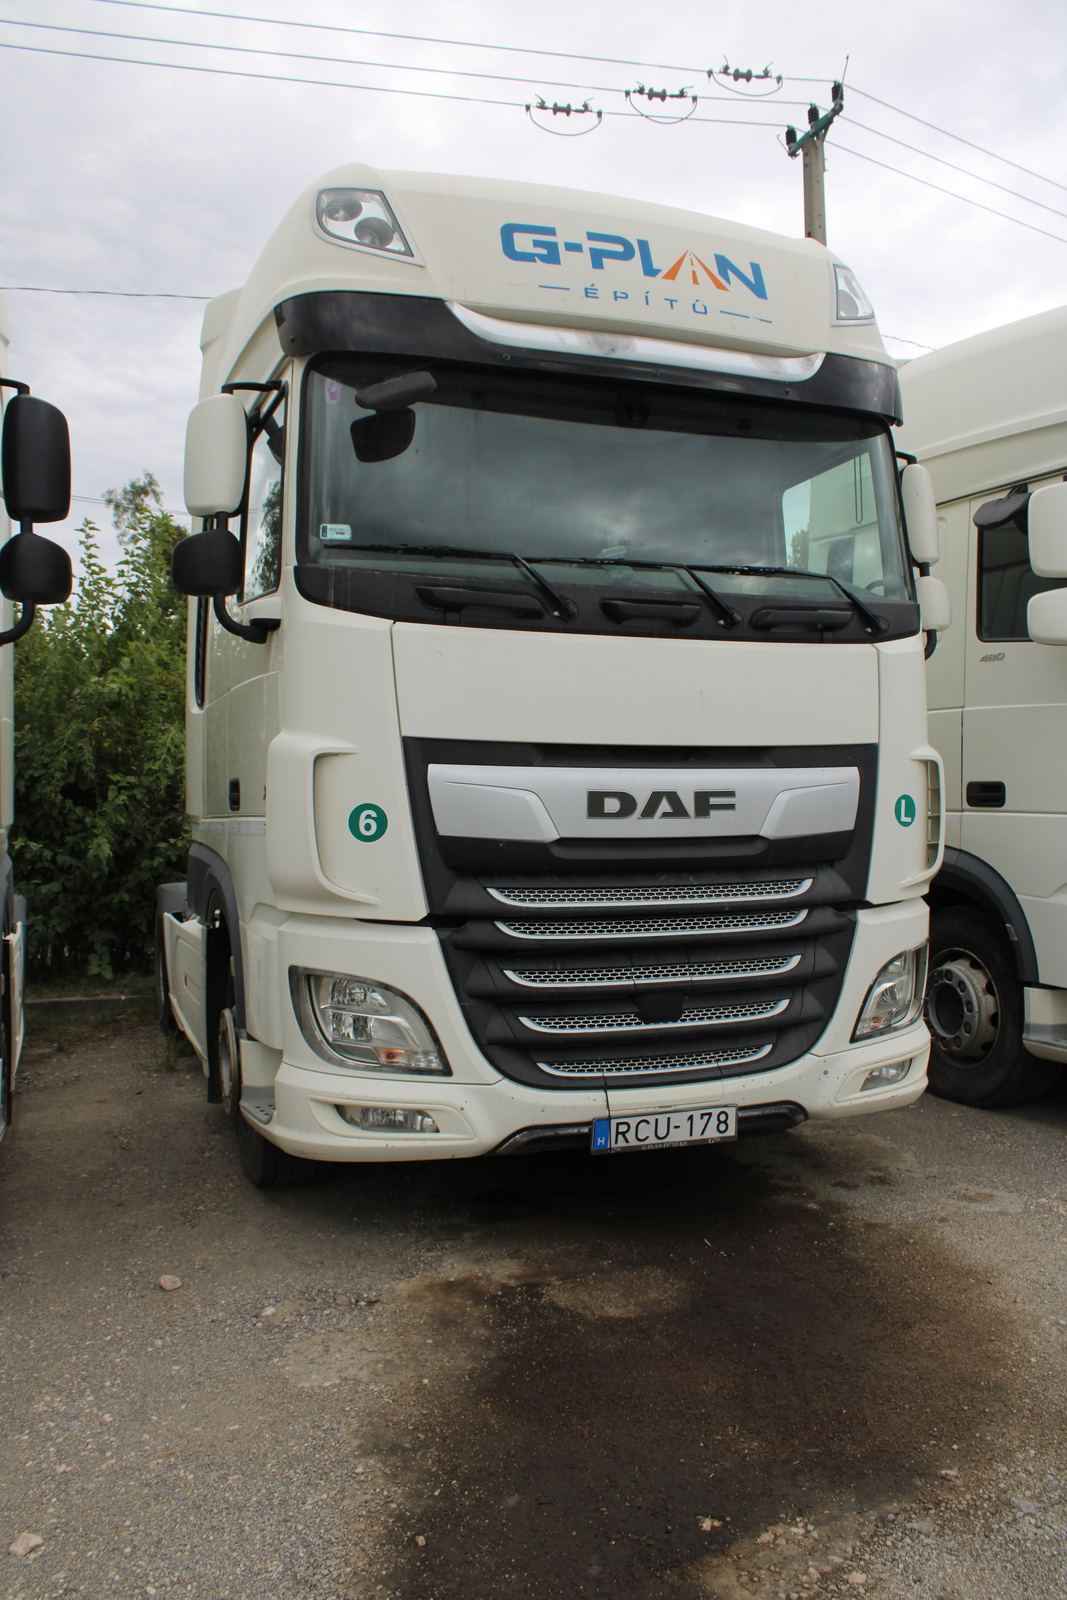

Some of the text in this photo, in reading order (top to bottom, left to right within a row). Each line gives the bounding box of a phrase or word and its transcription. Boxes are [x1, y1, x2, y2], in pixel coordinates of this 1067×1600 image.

[500, 222, 769, 301] G-PLAN
[979, 652, 1006, 663] 480
[586, 789, 736, 819] DAF
[900, 799, 912, 823] L
[358, 809, 378, 836] 6
[597, 1136, 605, 1146] H
[614, 1110, 730, 1145] RCU-178
